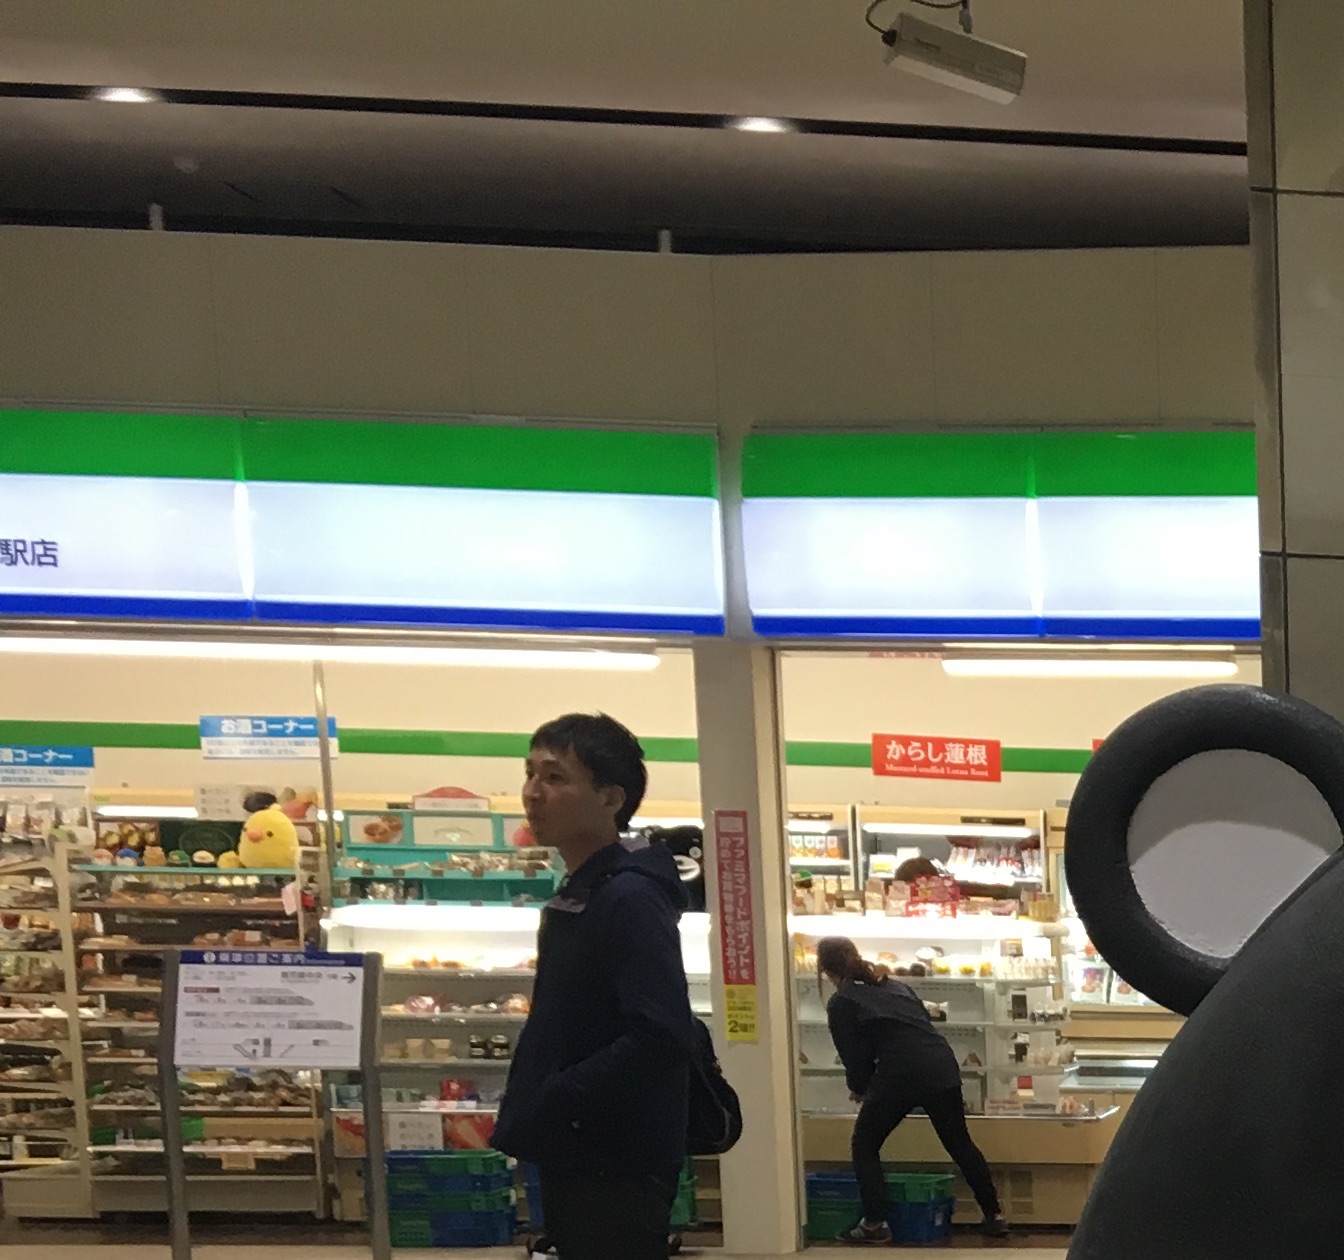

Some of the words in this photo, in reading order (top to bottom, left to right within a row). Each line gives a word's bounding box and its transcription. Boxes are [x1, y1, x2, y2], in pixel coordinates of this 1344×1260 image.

[0, 538, 59, 568] 駅店
[885, 739, 988, 766] からし蓮根
